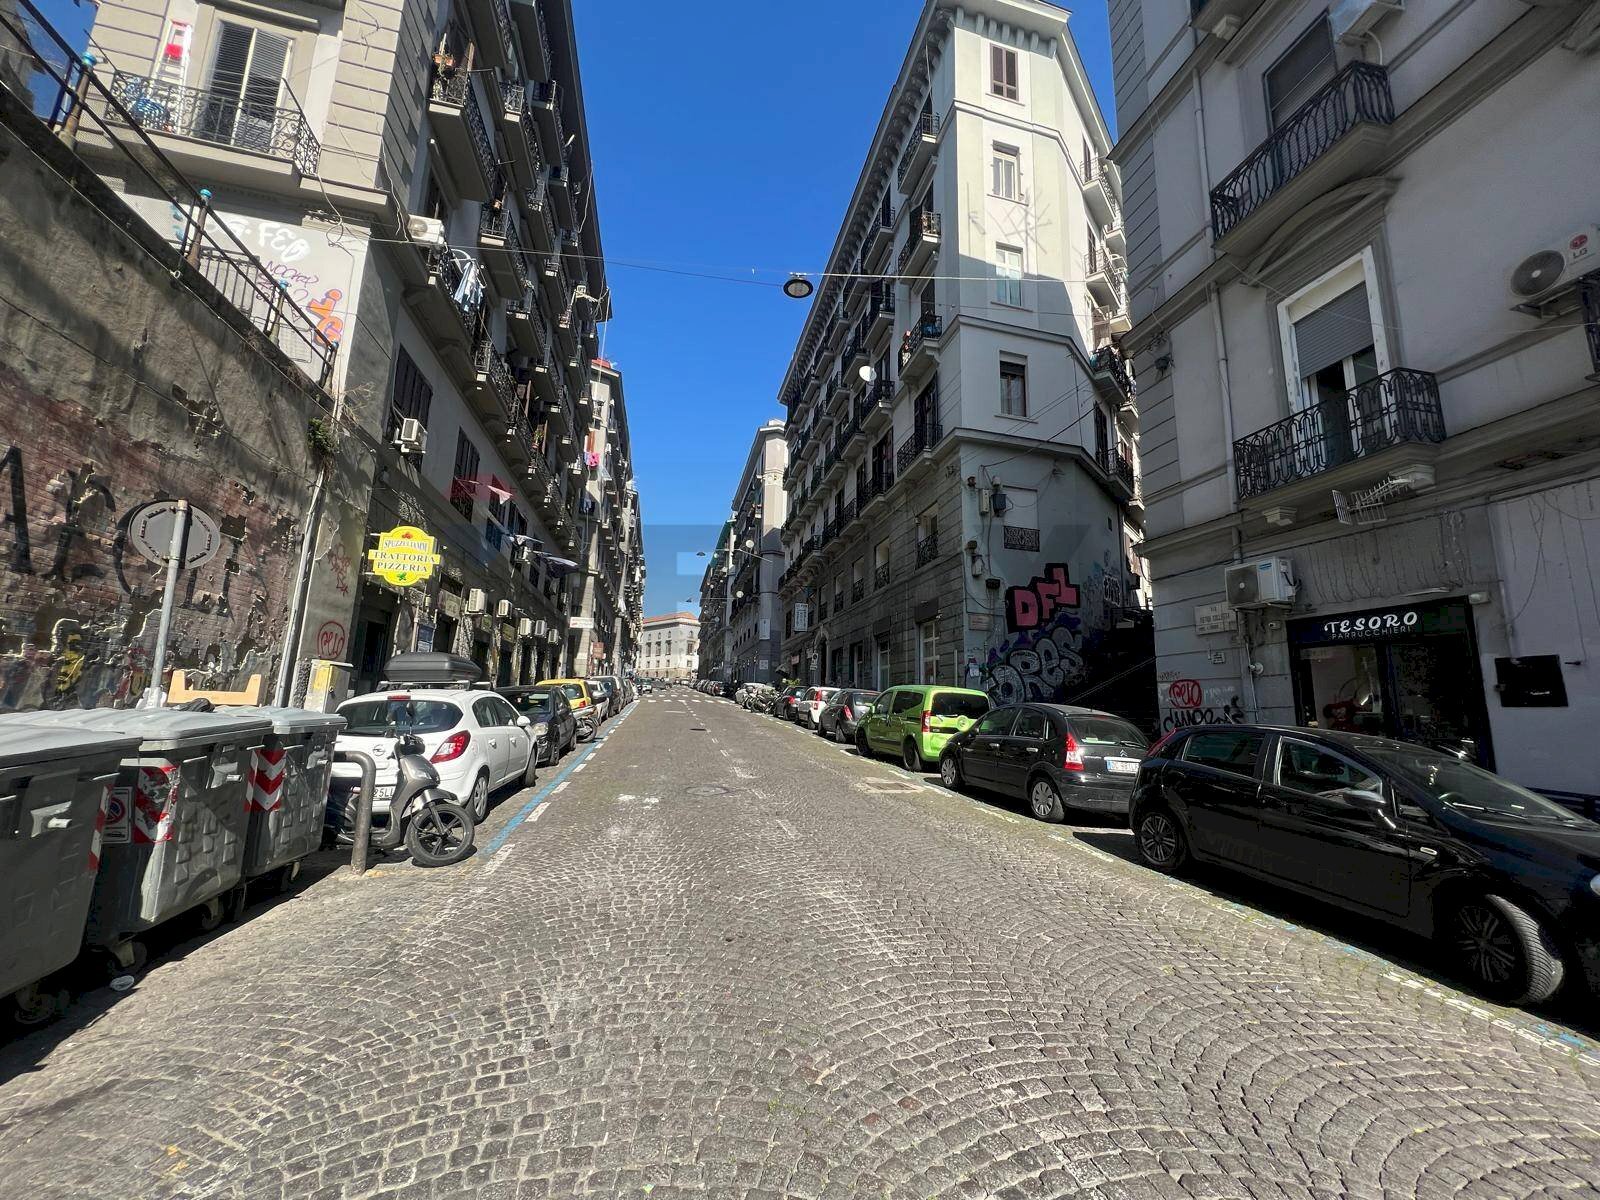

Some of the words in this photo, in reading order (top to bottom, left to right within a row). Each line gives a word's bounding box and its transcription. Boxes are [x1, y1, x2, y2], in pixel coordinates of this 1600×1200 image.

[374, 552, 436, 563] TRATTORIA
[377, 562, 428, 572] PIZZERIA
[1324, 611, 1418, 634] TESORO
[1331, 626, 1411, 640] PARRUCCHIERI
